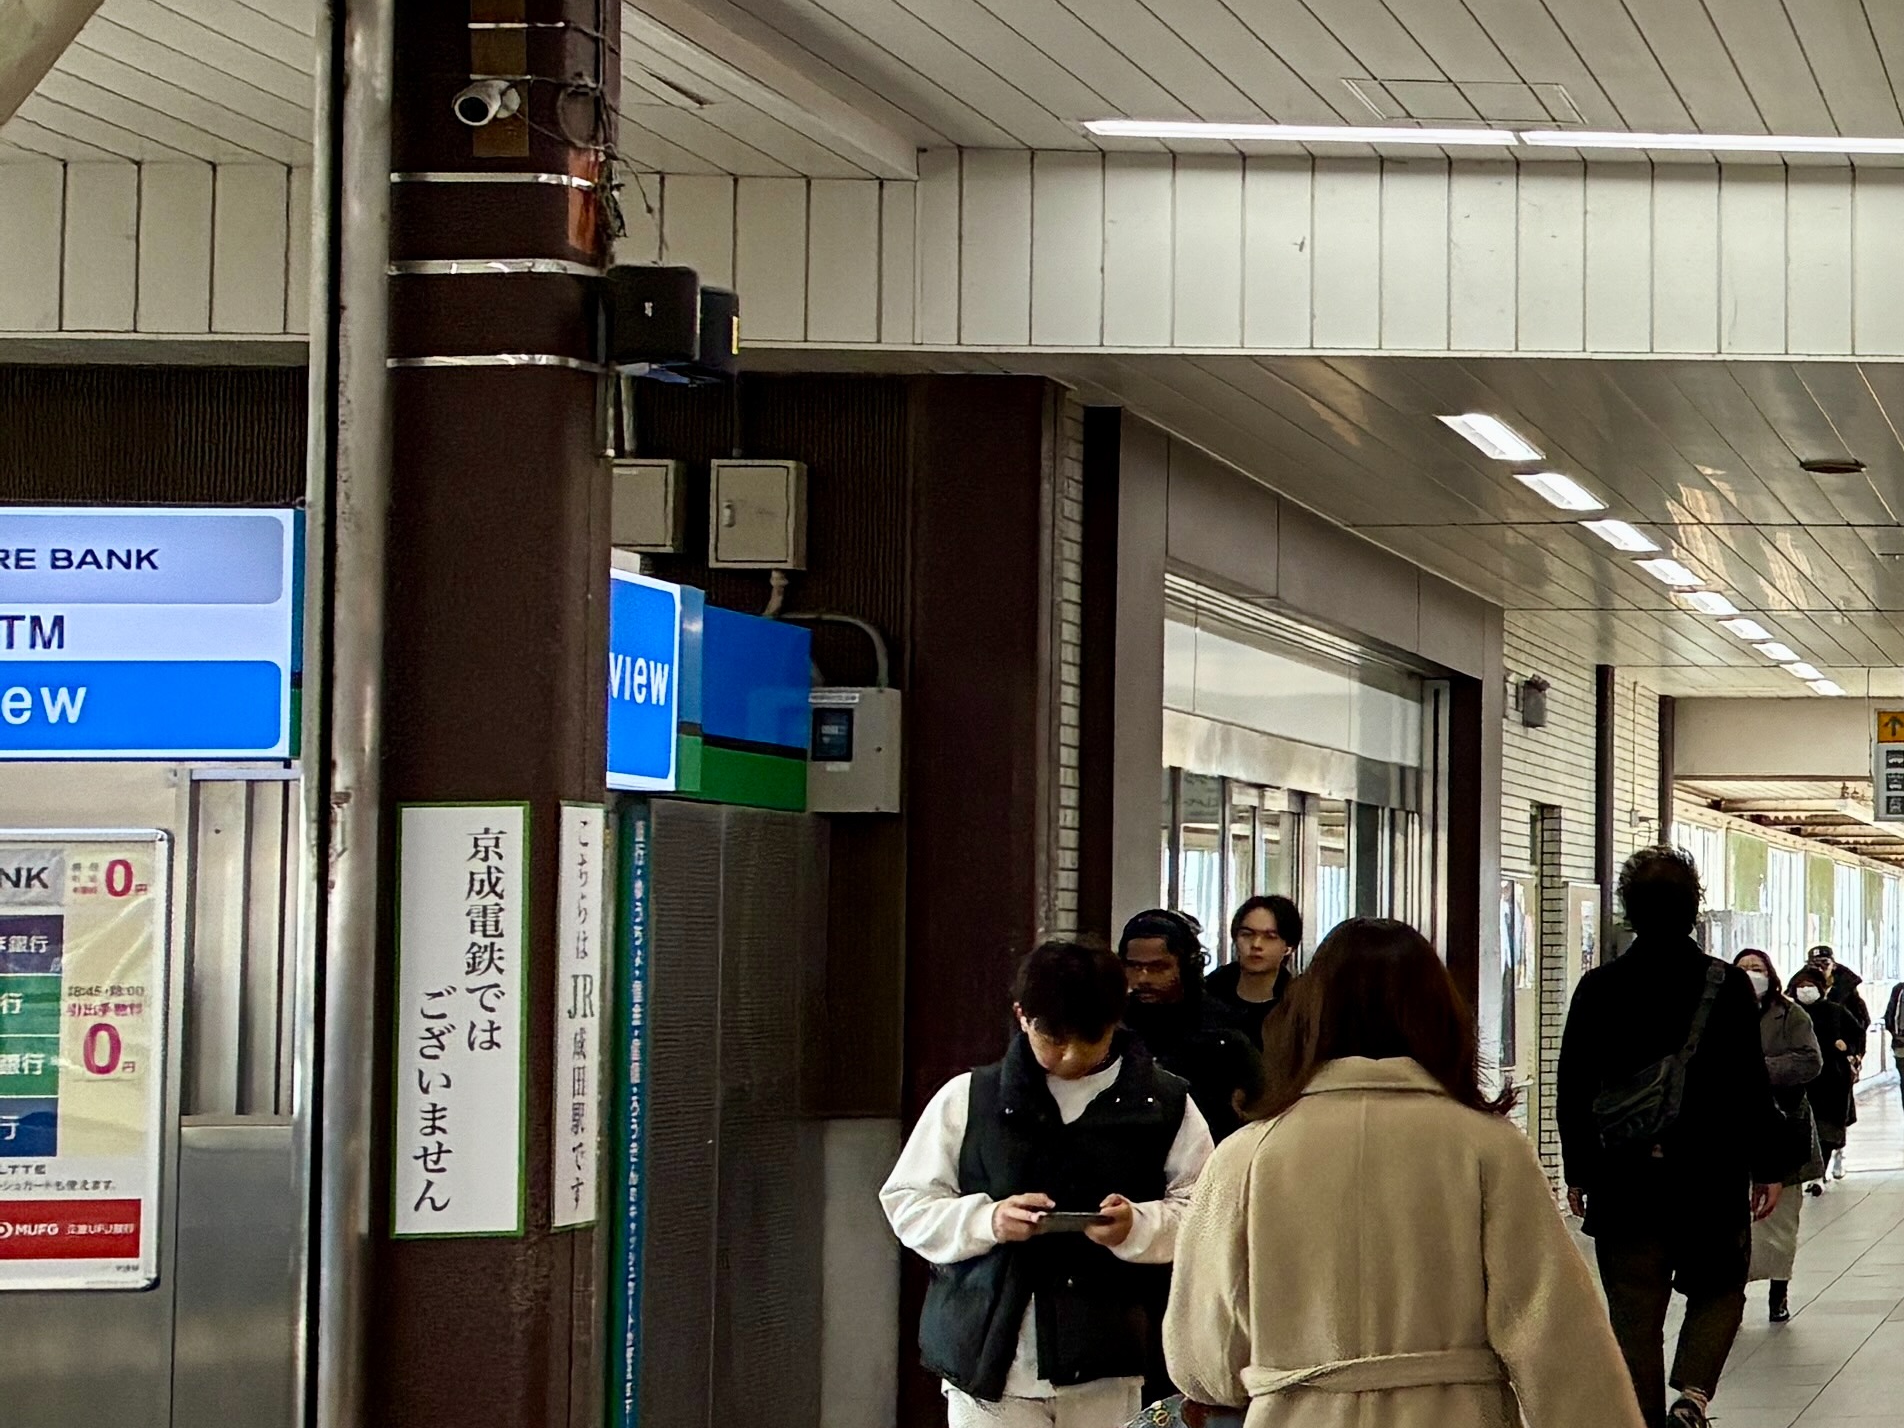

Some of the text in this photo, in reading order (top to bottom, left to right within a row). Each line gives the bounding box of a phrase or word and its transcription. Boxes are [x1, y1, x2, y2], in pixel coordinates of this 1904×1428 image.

[50, 548, 159, 570] BANK
[608, 652, 669, 707] view
[464, 826, 507, 1053] 京成電鉄では
[566, 820, 595, 1210] こちらはJR成田駅です
[411, 985, 455, 1215] ございません
[15, 1224, 59, 1235] MUFG
